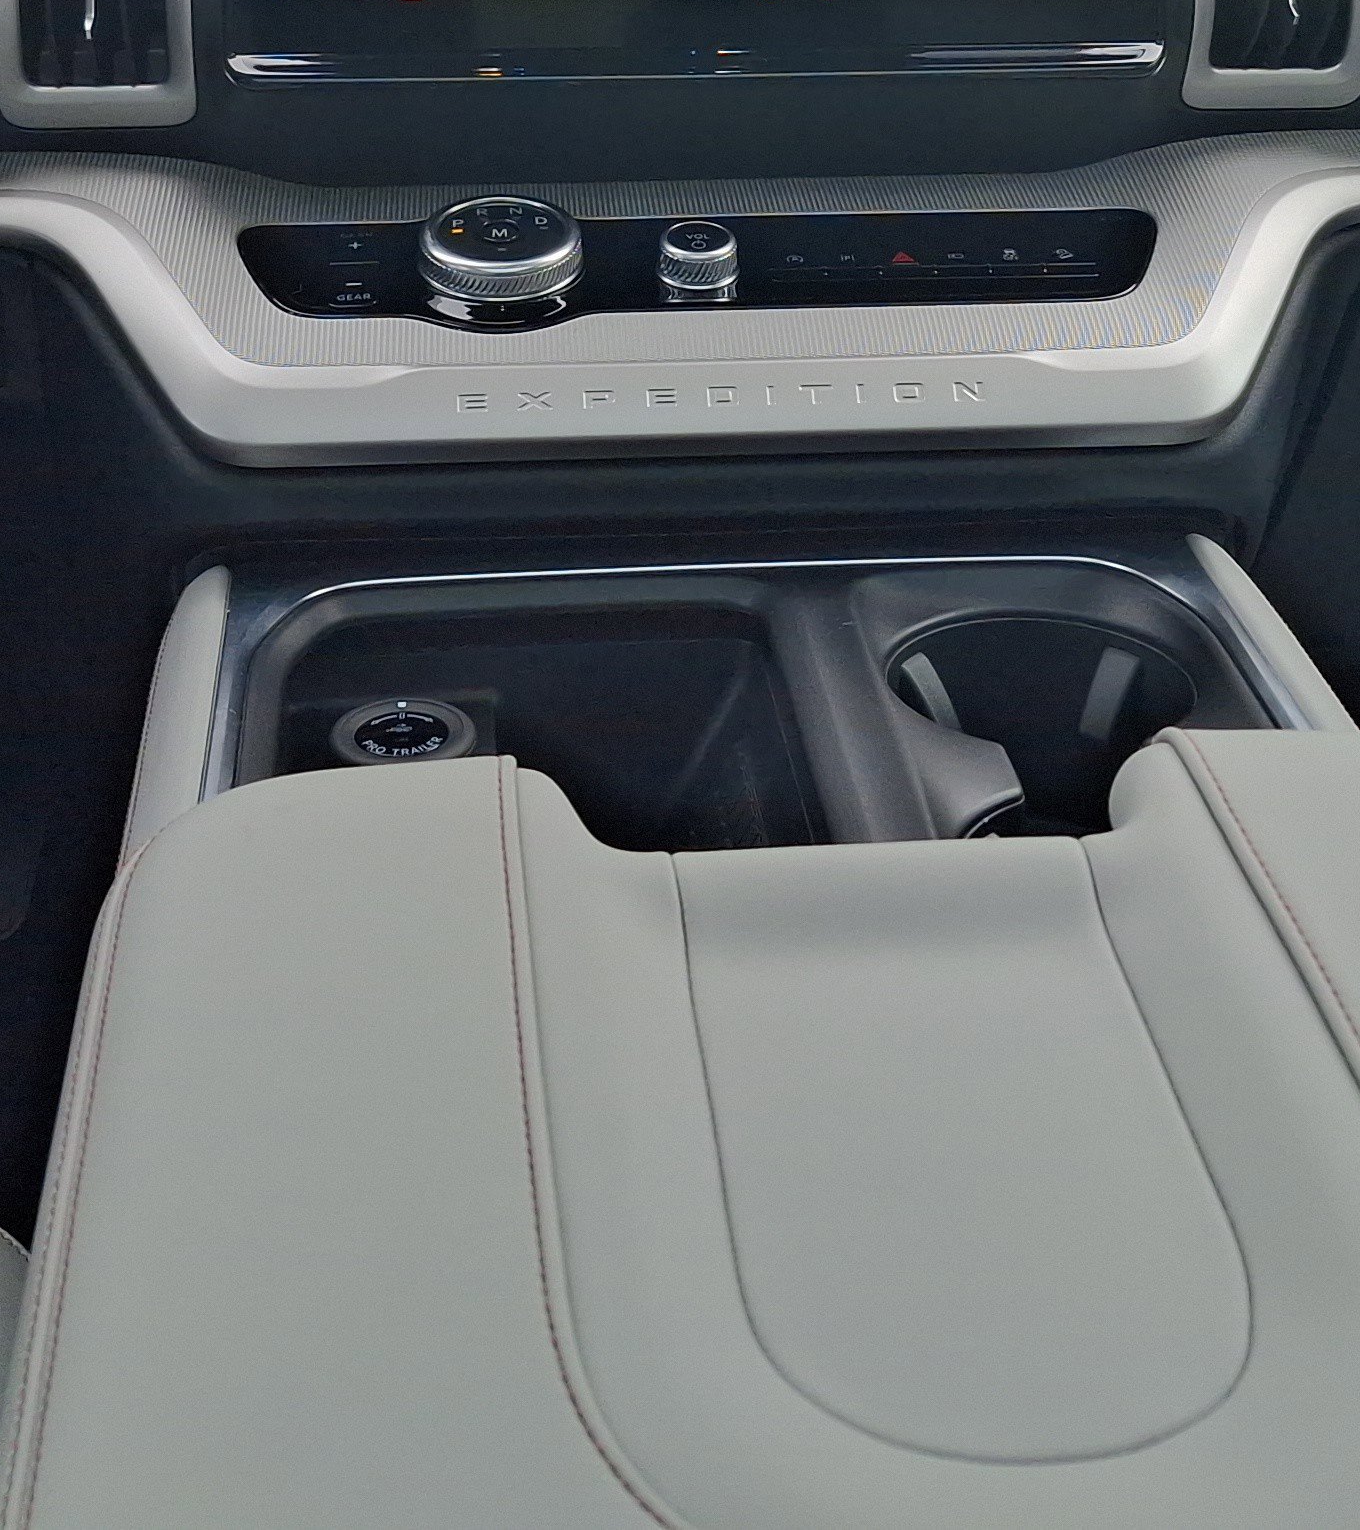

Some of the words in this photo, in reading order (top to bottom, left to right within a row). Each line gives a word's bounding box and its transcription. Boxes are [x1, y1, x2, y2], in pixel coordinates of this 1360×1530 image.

[509, 207, 523, 215] N
[452, 219, 464, 228] P
[534, 216, 548, 225] D
[491, 228, 508, 238] M
[336, 292, 371, 302] GEAR
[457, 381, 983, 413] EXPEDITION
[361, 739, 387, 755] PRO
[392, 735, 443, 757] TRAILER
